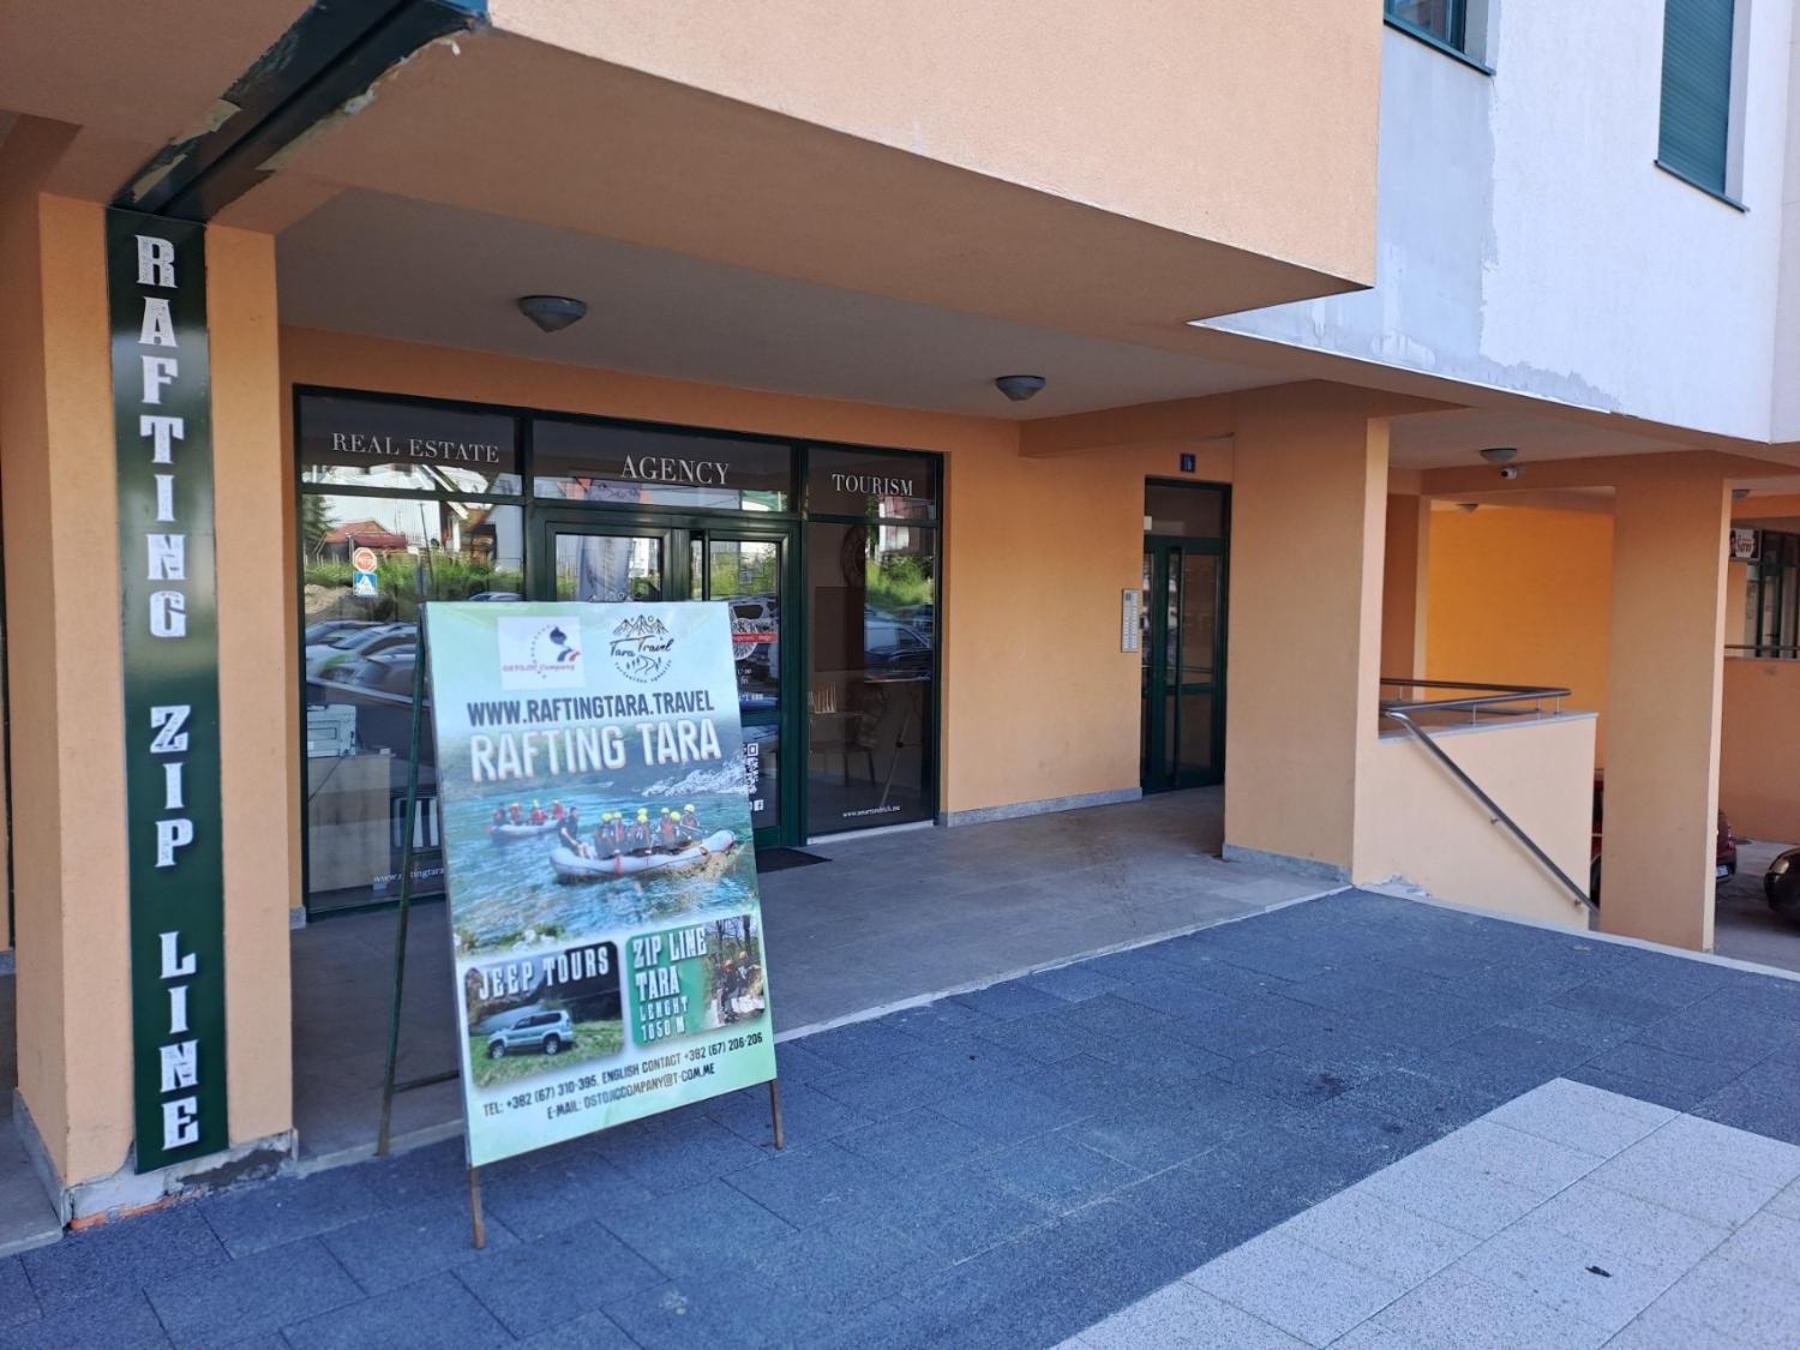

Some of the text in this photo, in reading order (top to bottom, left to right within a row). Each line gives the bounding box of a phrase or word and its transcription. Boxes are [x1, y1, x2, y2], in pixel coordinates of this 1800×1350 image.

[332, 432, 500, 464] REAL ESTATE
[621, 453, 730, 486] AGENCY
[832, 473, 914, 497] TOURISM
[609, 635, 674, 657] Tara Travel
[135, 234, 199, 1150] RAFTING ZIP LINE
[467, 689, 715, 727] WWW.RAFTINGTARA.TRAVEL
[470, 717, 722, 783] RAFTING TARA
[632, 927, 708, 968] ZIP LINE
[478, 946, 610, 1001] JEEP TOURS
[635, 965, 680, 1002] TARA
[483, 1102, 504, 1117] TEL:
[506, 1092, 532, 1109] +382
[534, 1086, 555, 1103] (67)
[602, 1063, 640, 1084] ENGLISH
[642, 1052, 681, 1073] CONTACT
[708, 1042, 726, 1057] (67)
